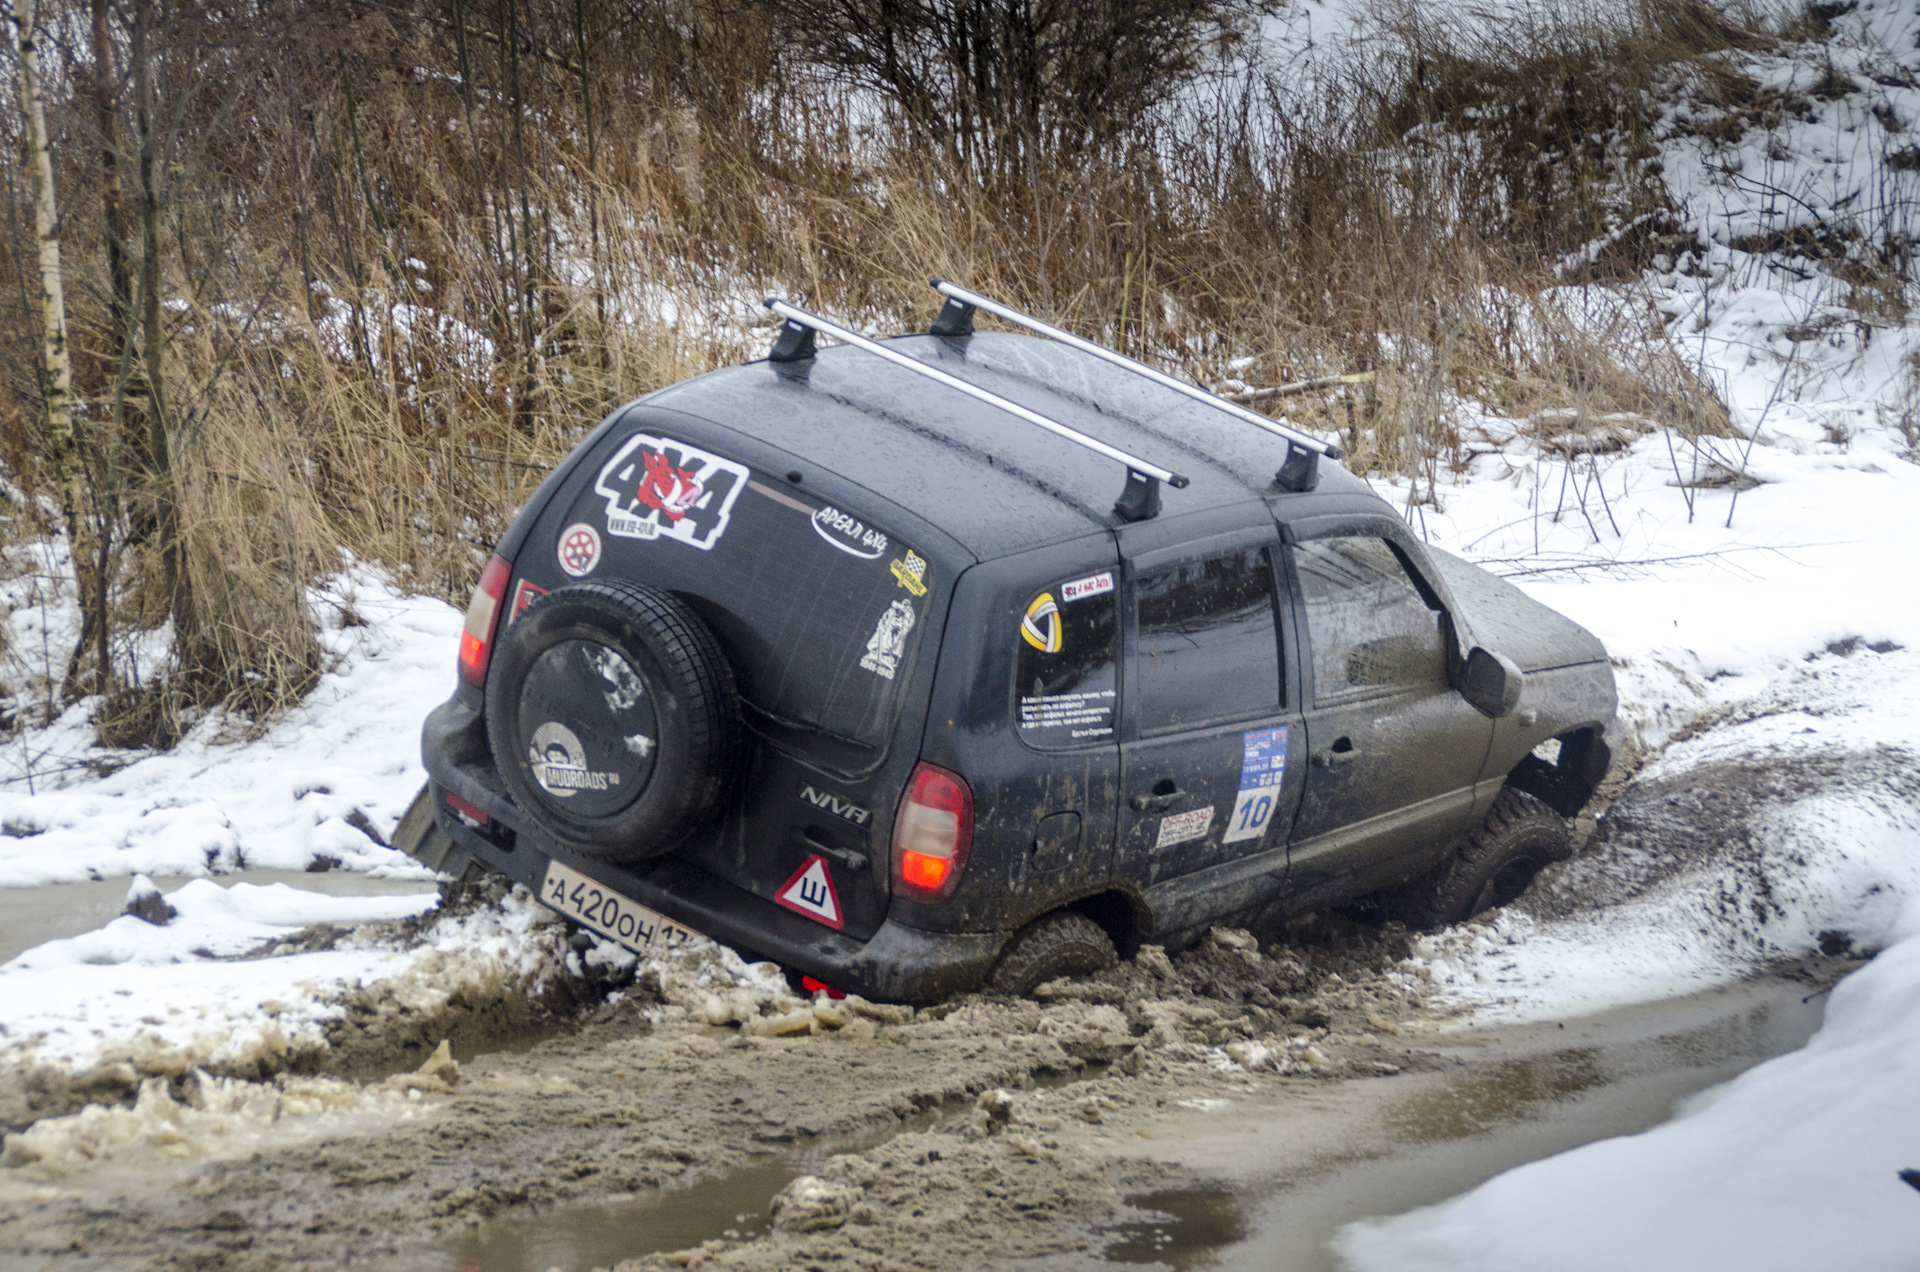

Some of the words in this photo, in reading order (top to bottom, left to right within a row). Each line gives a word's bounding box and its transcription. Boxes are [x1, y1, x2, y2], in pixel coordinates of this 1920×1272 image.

[816, 506, 864, 539] АРЕАЛ
[891, 559, 925, 595] BARDAHL
[546, 768, 608, 790] MUDROADS
[799, 786, 870, 824] NIVA
[1240, 795, 1271, 831] 10
[799, 876, 827, 908] Ш
